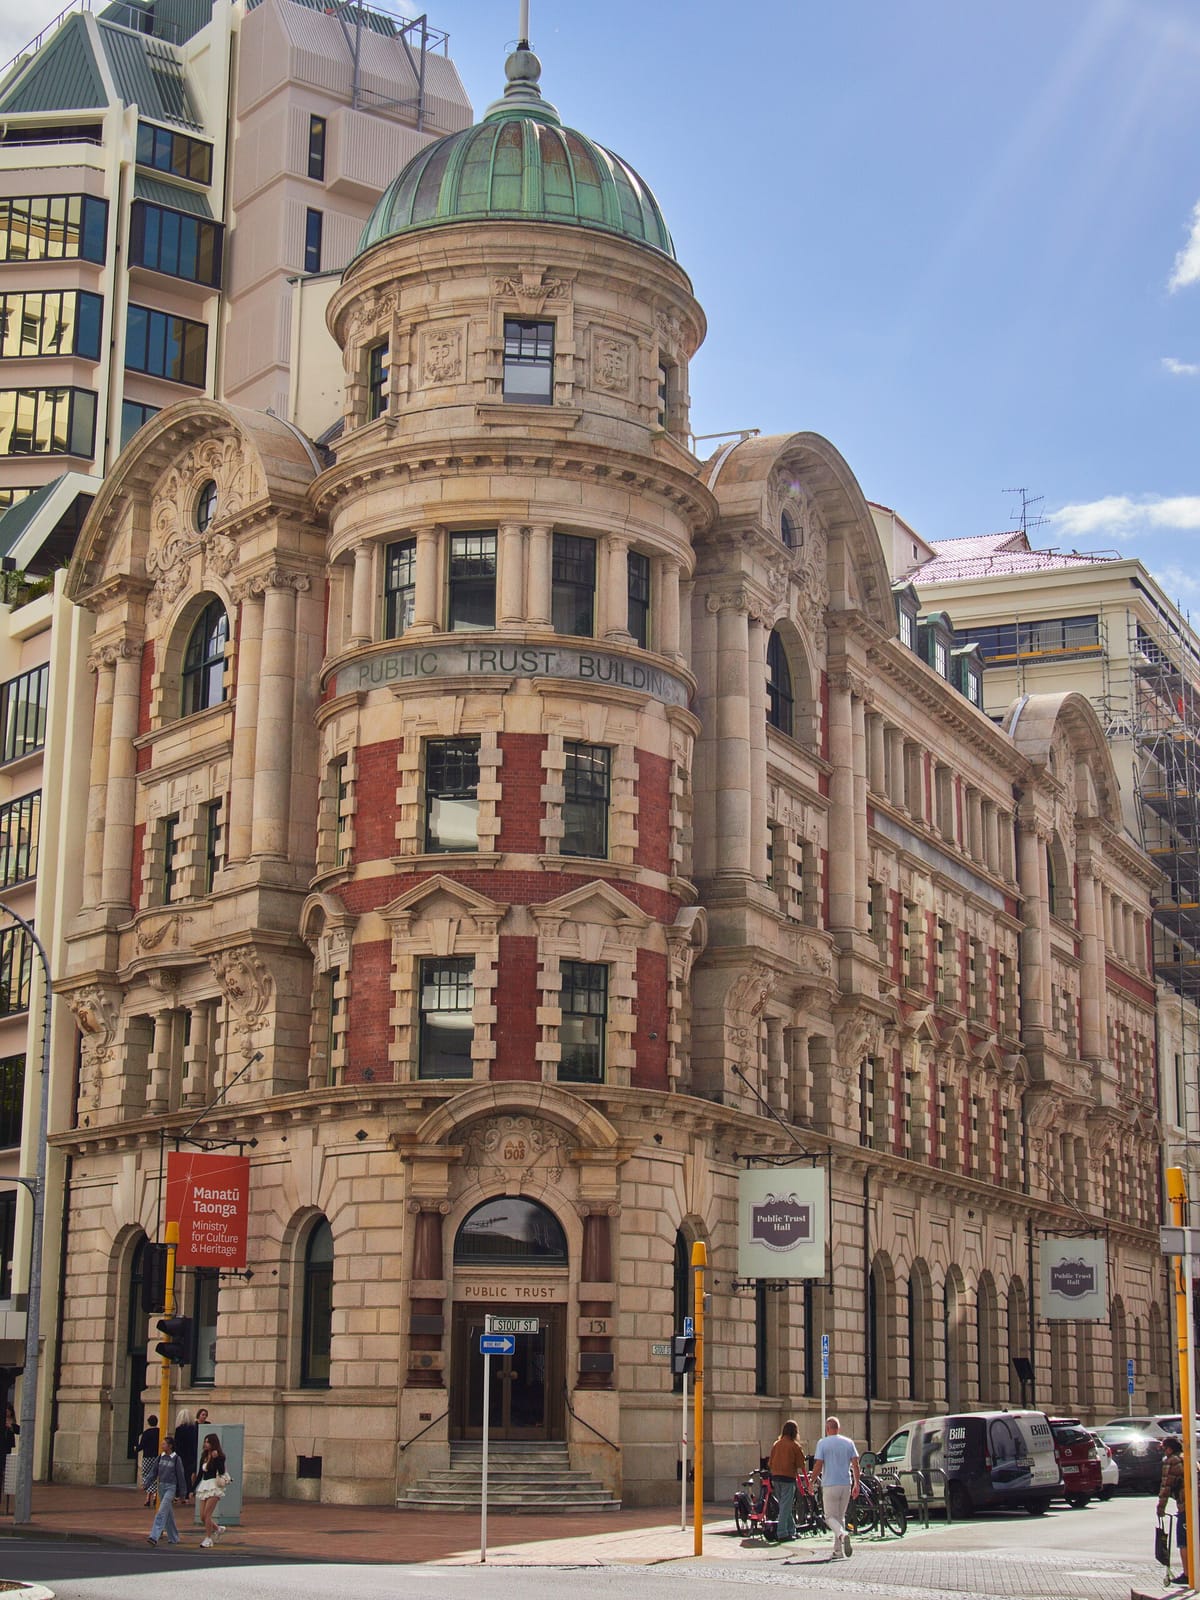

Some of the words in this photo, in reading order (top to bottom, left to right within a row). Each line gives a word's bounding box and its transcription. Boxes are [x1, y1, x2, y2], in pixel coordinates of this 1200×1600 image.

[359, 652, 438, 687] PUBLIC
[462, 650, 556, 673] TRUST
[193, 1187, 240, 1200] Manatū
[193, 1201, 237, 1217] Taonga
[192, 1220, 228, 1234] Ministry
[774, 1223, 791, 1231] Hall
[191, 1231, 205, 1242] for
[206, 1233, 239, 1243] Culture
[191, 1243, 198, 1253] &
[199, 1244, 237, 1256] Heritage
[465, 1286, 507, 1297] PUBLIC
[515, 1287, 556, 1298] TRUST
[498, 1320, 521, 1331] STOUT
[523, 1321, 534, 1331] ST
[589, 1320, 607, 1334] 131
[949, 1427, 966, 1440] Billi
[1030, 1424, 1050, 1436] Billi
